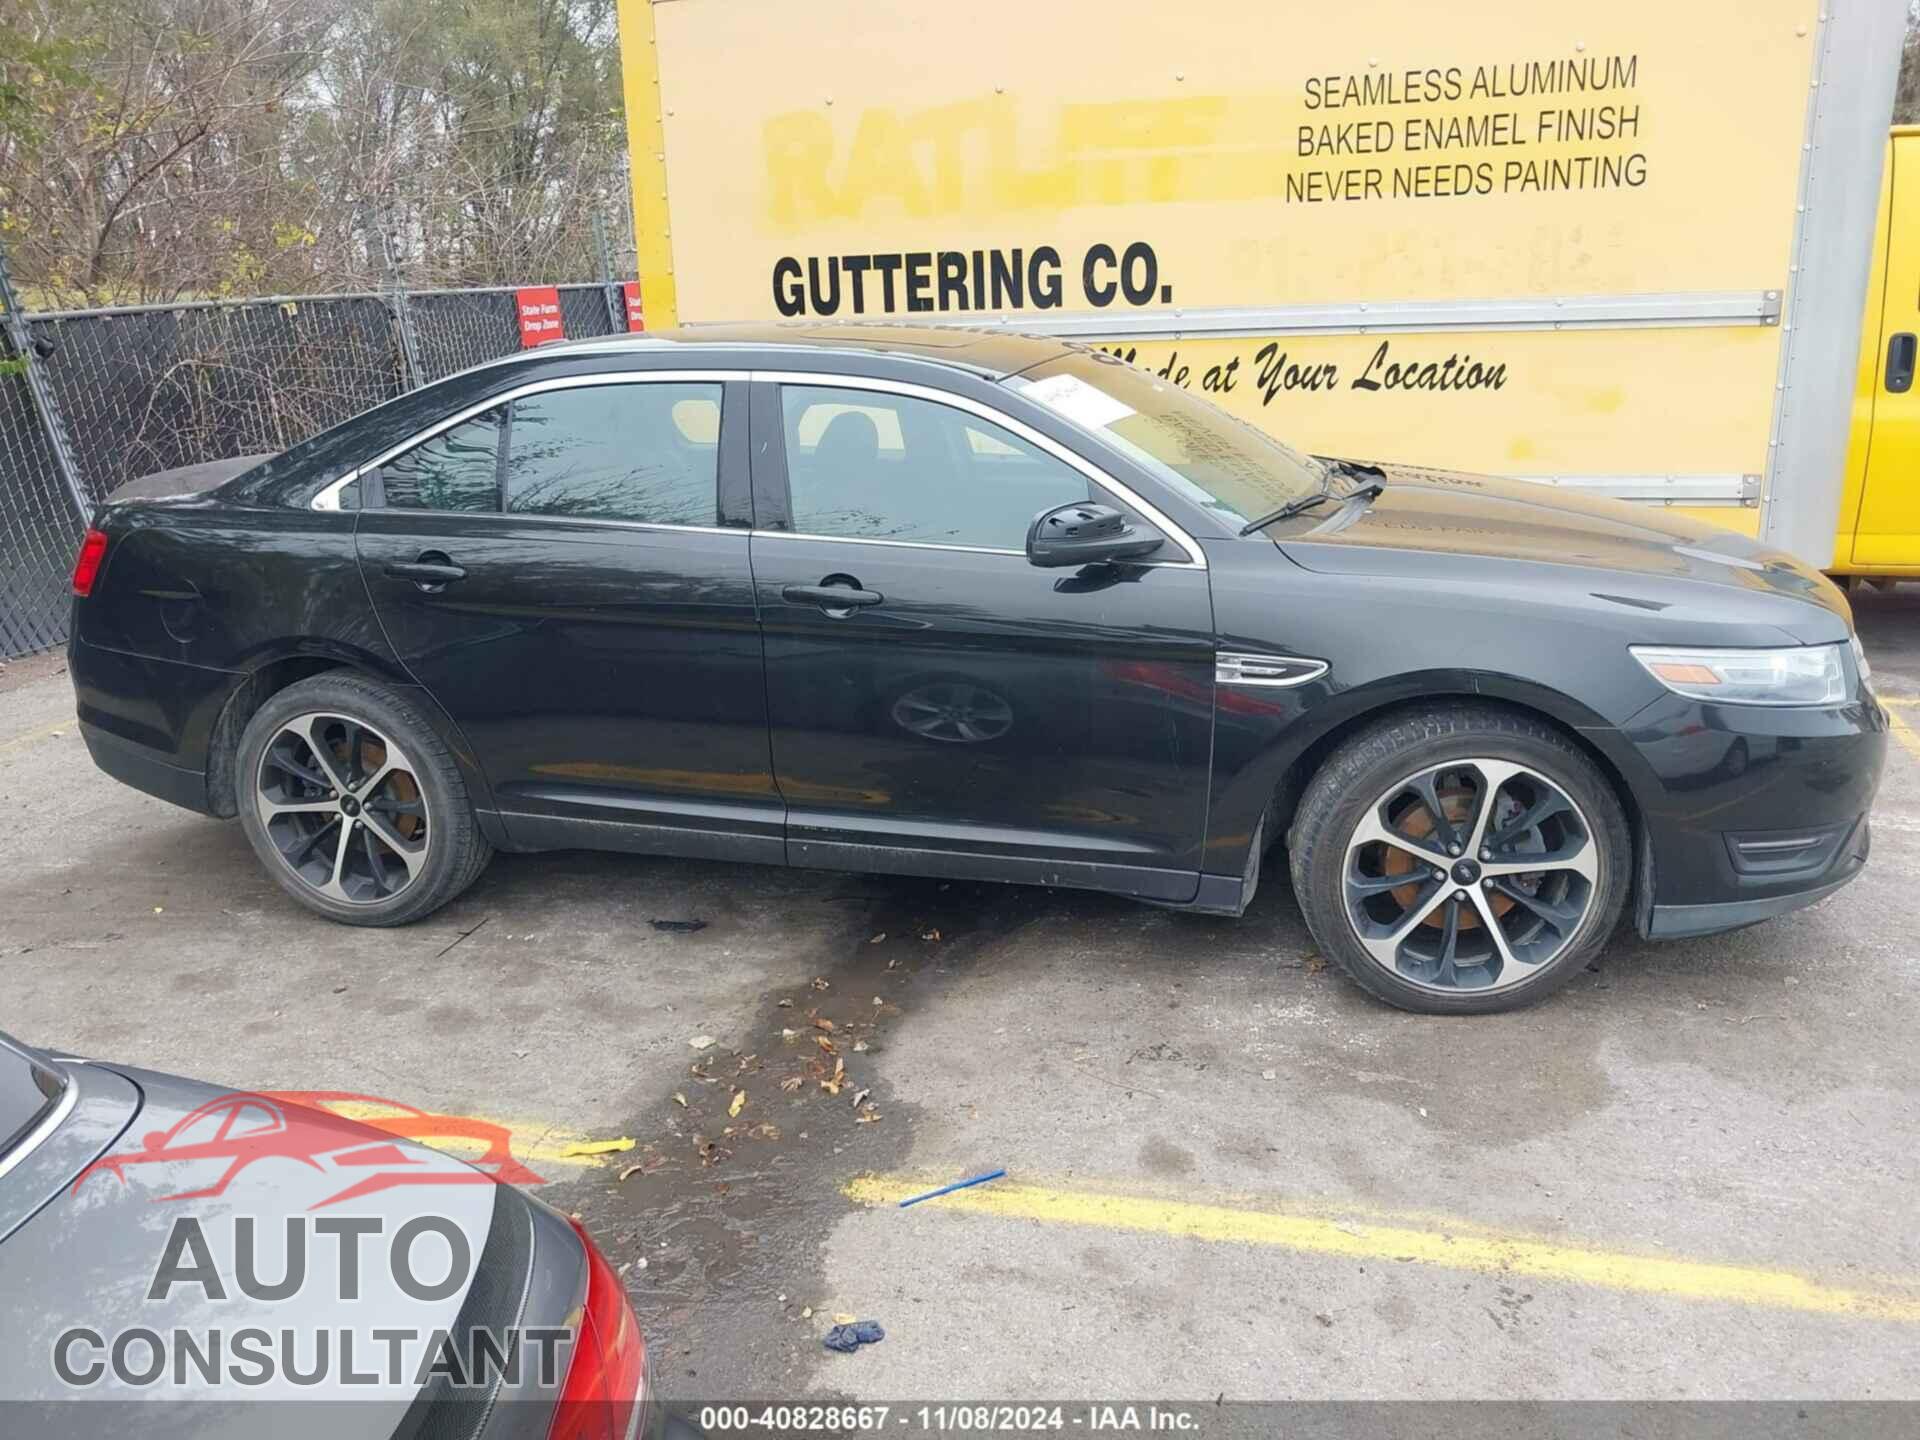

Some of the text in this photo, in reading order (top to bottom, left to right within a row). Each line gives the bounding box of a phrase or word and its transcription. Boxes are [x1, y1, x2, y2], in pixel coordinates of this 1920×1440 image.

[1304, 54, 1638, 110] SEAMLESS ALUMINUM
[1298, 105, 1640, 157] BAKED ENAMEL FINISH
[1286, 153, 1648, 203] NEVER NEEDS PAINTING
[772, 246, 1063, 317] GUTTERING
[1082, 242, 1173, 307] CO.
[1202, 356, 1239, 393] at
[1254, 341, 1339, 407] Your
[1351, 340, 1508, 392] Location
